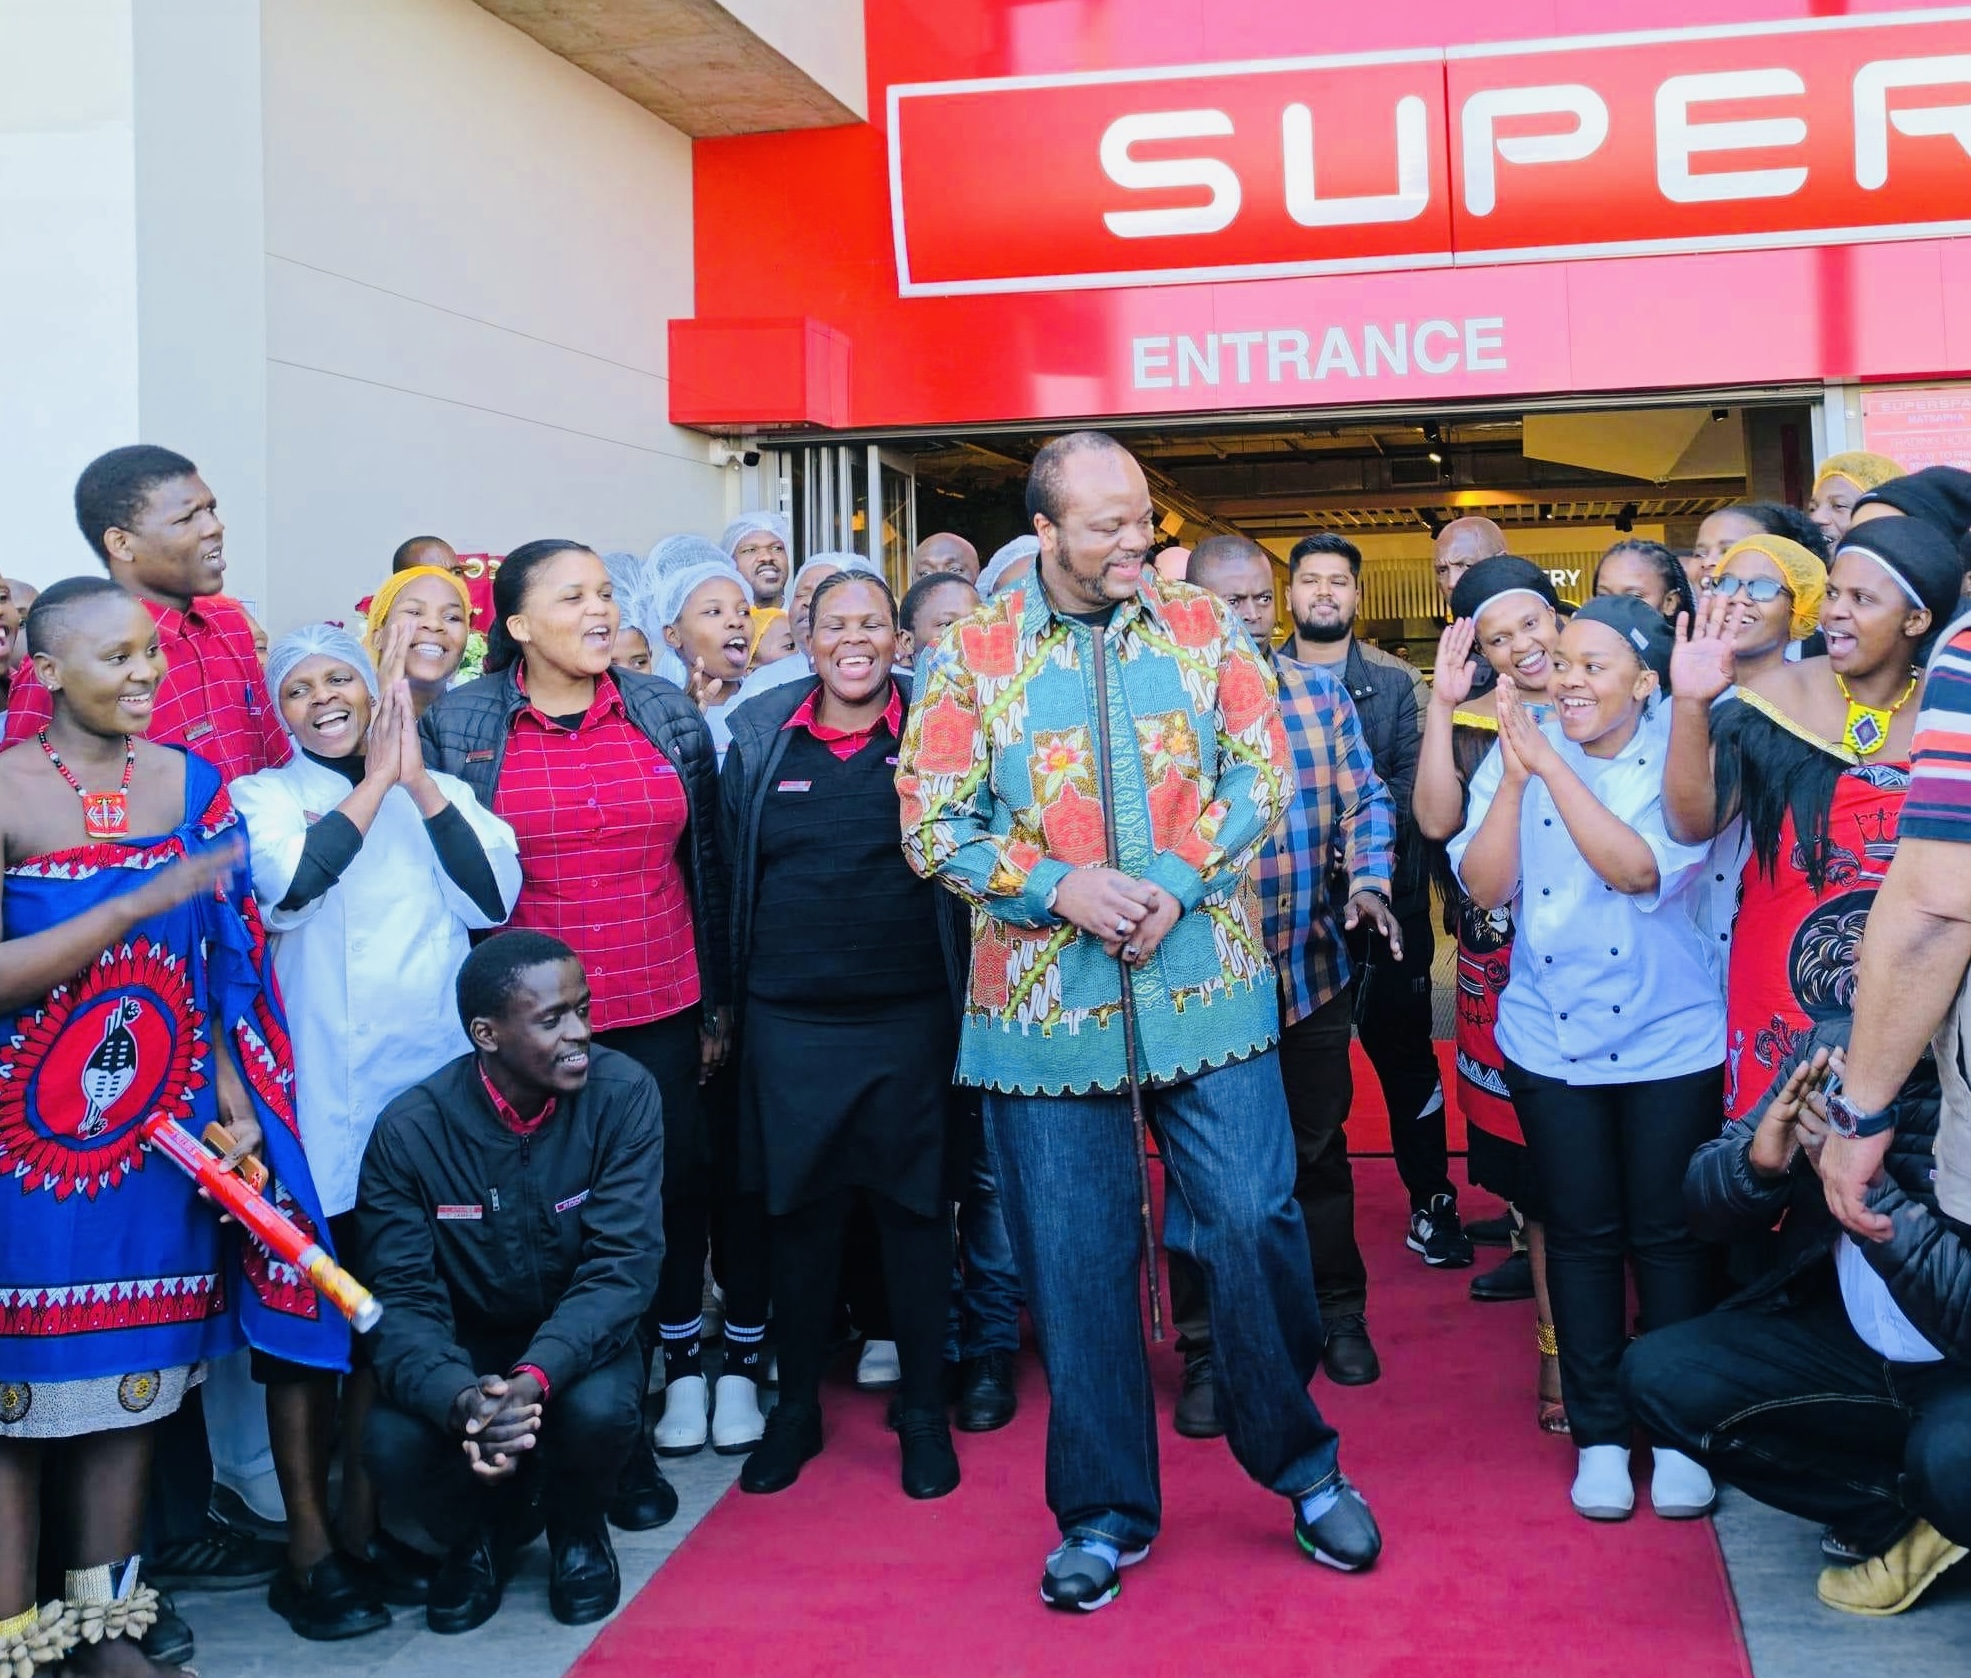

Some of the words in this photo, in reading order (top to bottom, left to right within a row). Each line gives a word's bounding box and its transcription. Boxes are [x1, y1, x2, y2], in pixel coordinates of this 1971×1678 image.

[1100, 54, 1971, 238] SUPER
[1132, 316, 1507, 389] ENTRANCE
[1541, 569, 1582, 588] RY
